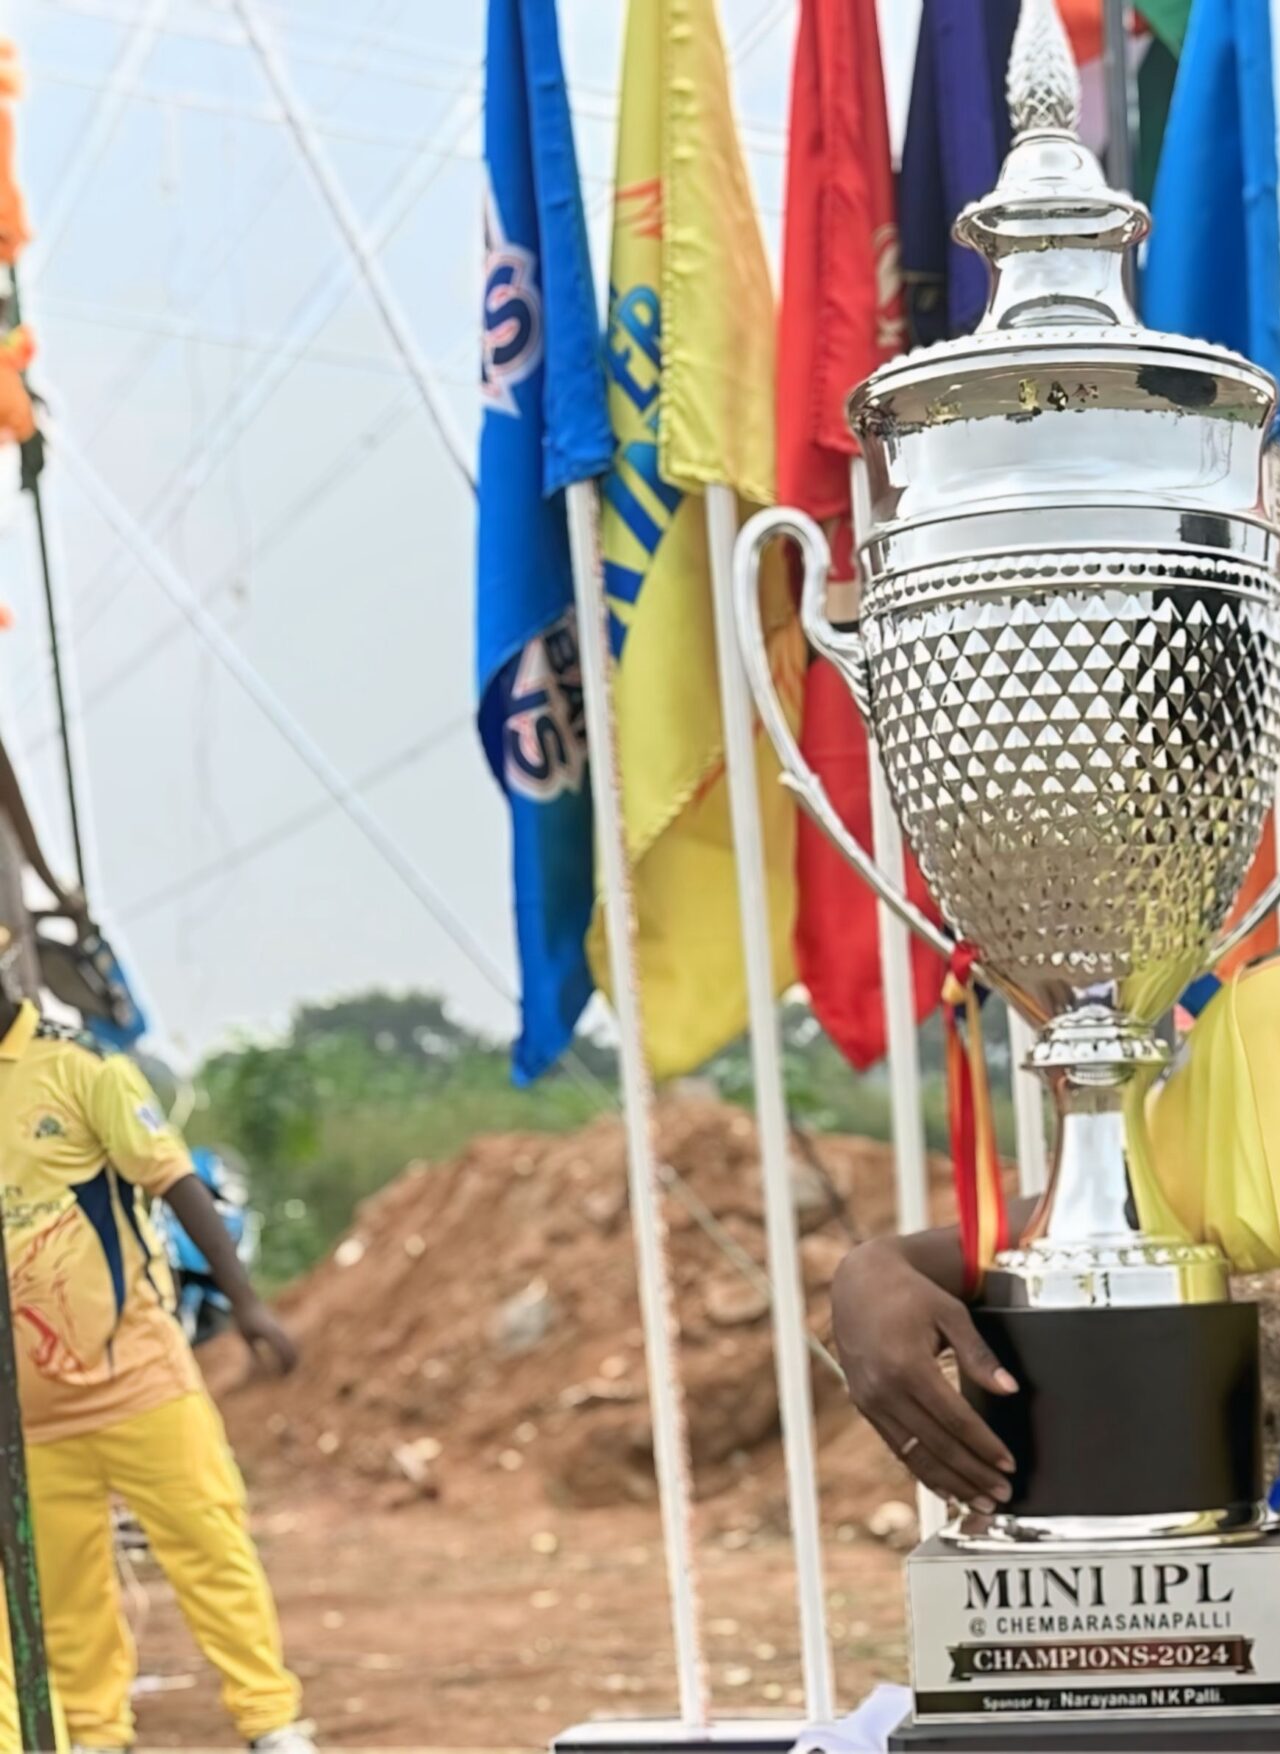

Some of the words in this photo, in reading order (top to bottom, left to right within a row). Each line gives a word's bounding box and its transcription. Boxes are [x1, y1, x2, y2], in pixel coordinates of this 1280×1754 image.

[963, 1566, 1105, 1610] MINI
[1130, 1563, 1234, 1606] IPL
[969, 1617, 987, 1638] @
[996, 1611, 1231, 1635] CHEMBARASANAPALLI
[973, 1644, 1230, 1671] CHAMPIONS-2024
[1060, 1691, 1148, 1710] Narayanan
